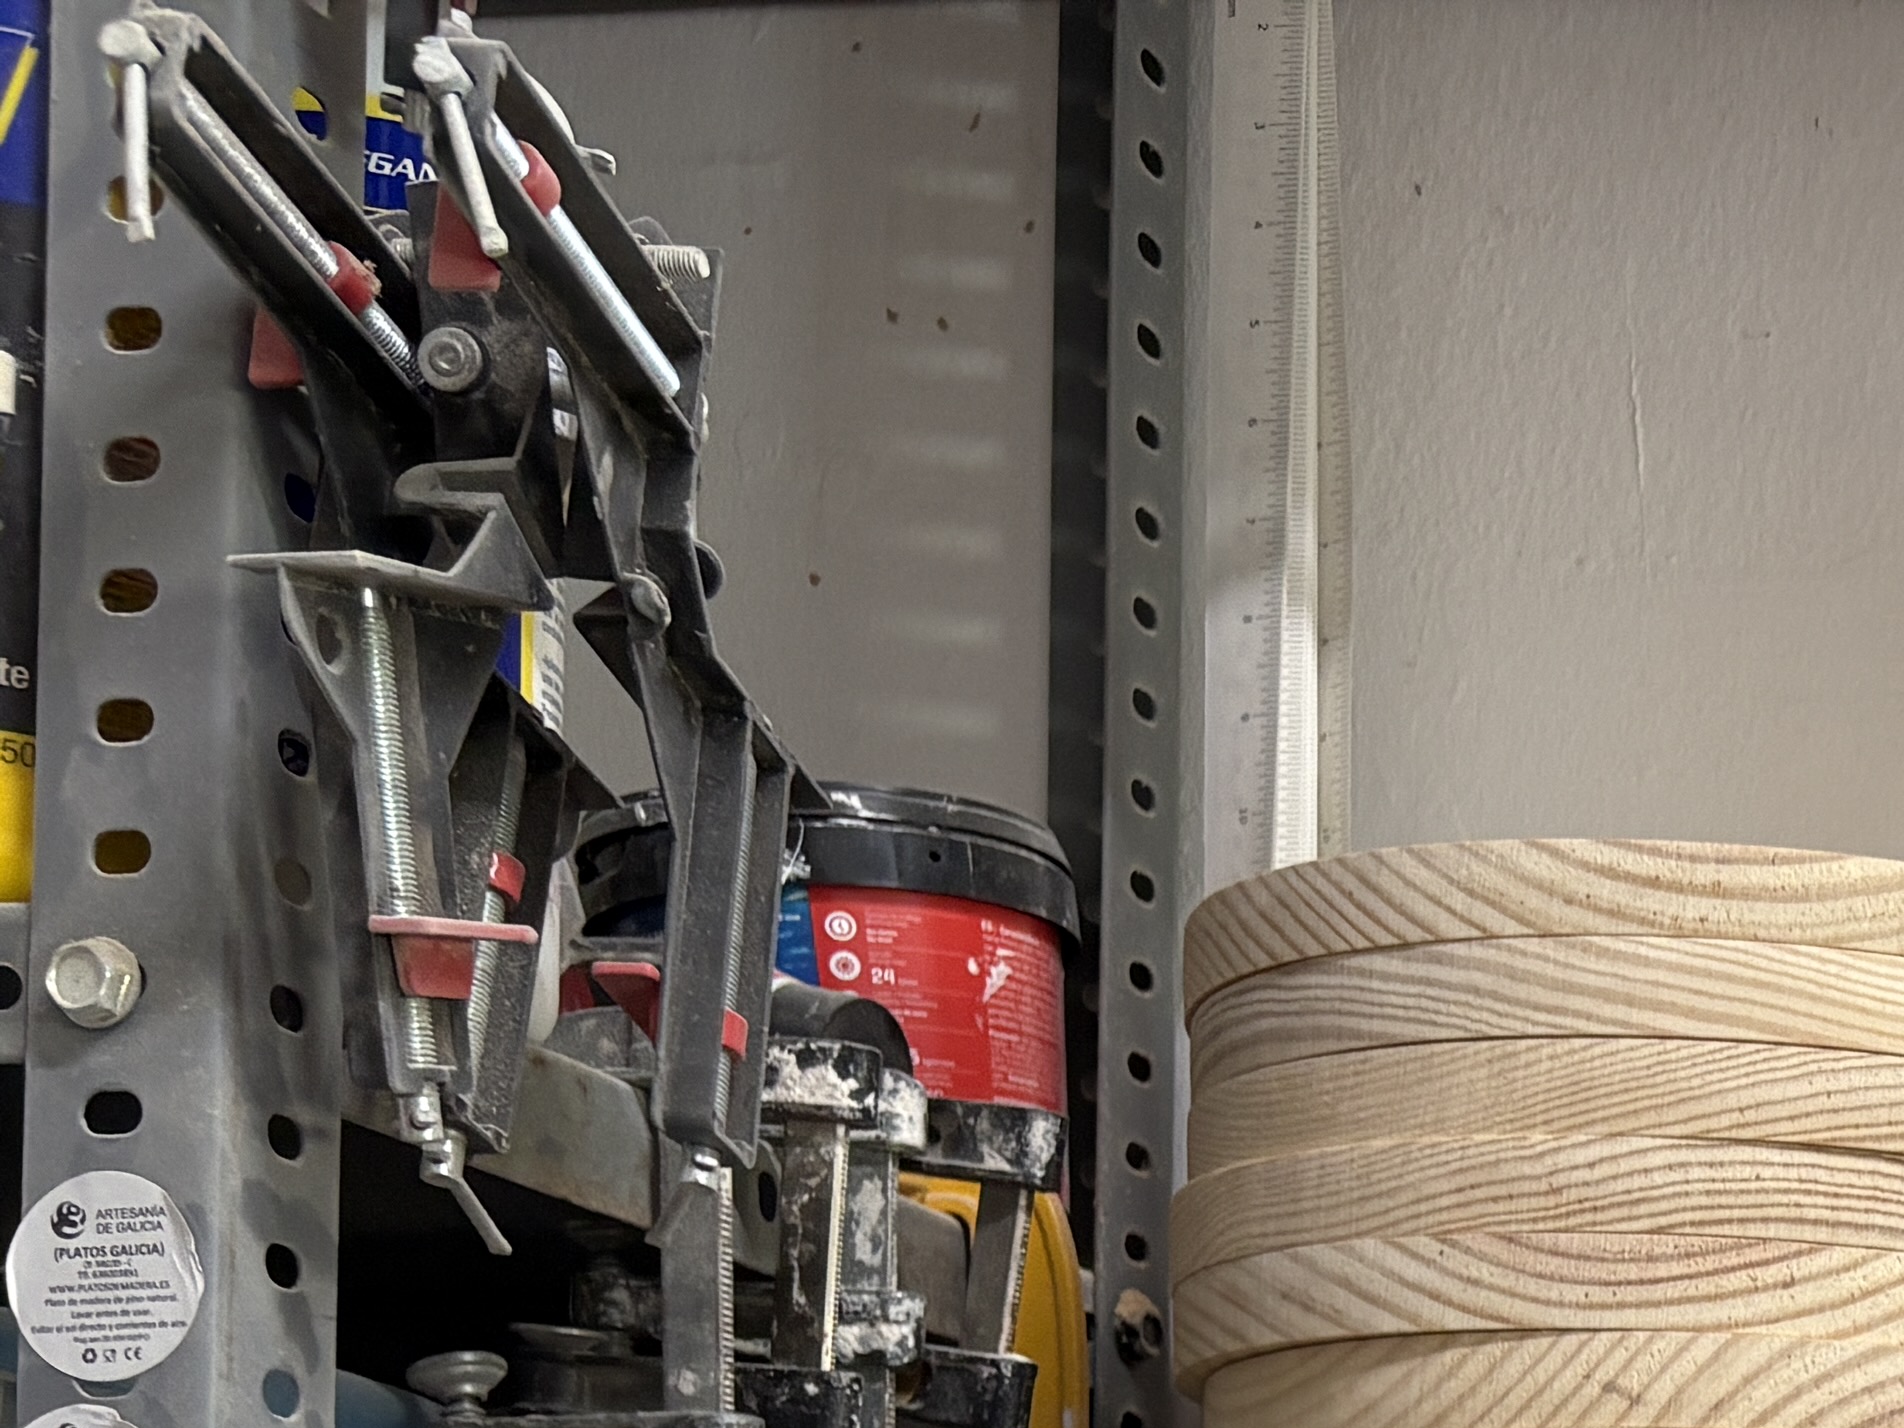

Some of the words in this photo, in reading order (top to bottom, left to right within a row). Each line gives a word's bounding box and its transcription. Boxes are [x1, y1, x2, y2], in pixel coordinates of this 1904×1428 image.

[364, 150, 440, 181] GA
[96, 1204, 166, 1220] ARTESANÍA
[96, 1223, 113, 1234] DE
[116, 1220, 164, 1234] GALICIA
[54, 1246, 107, 1263] (PLATOS
[110, 1241, 165, 1258] GALICIA)
